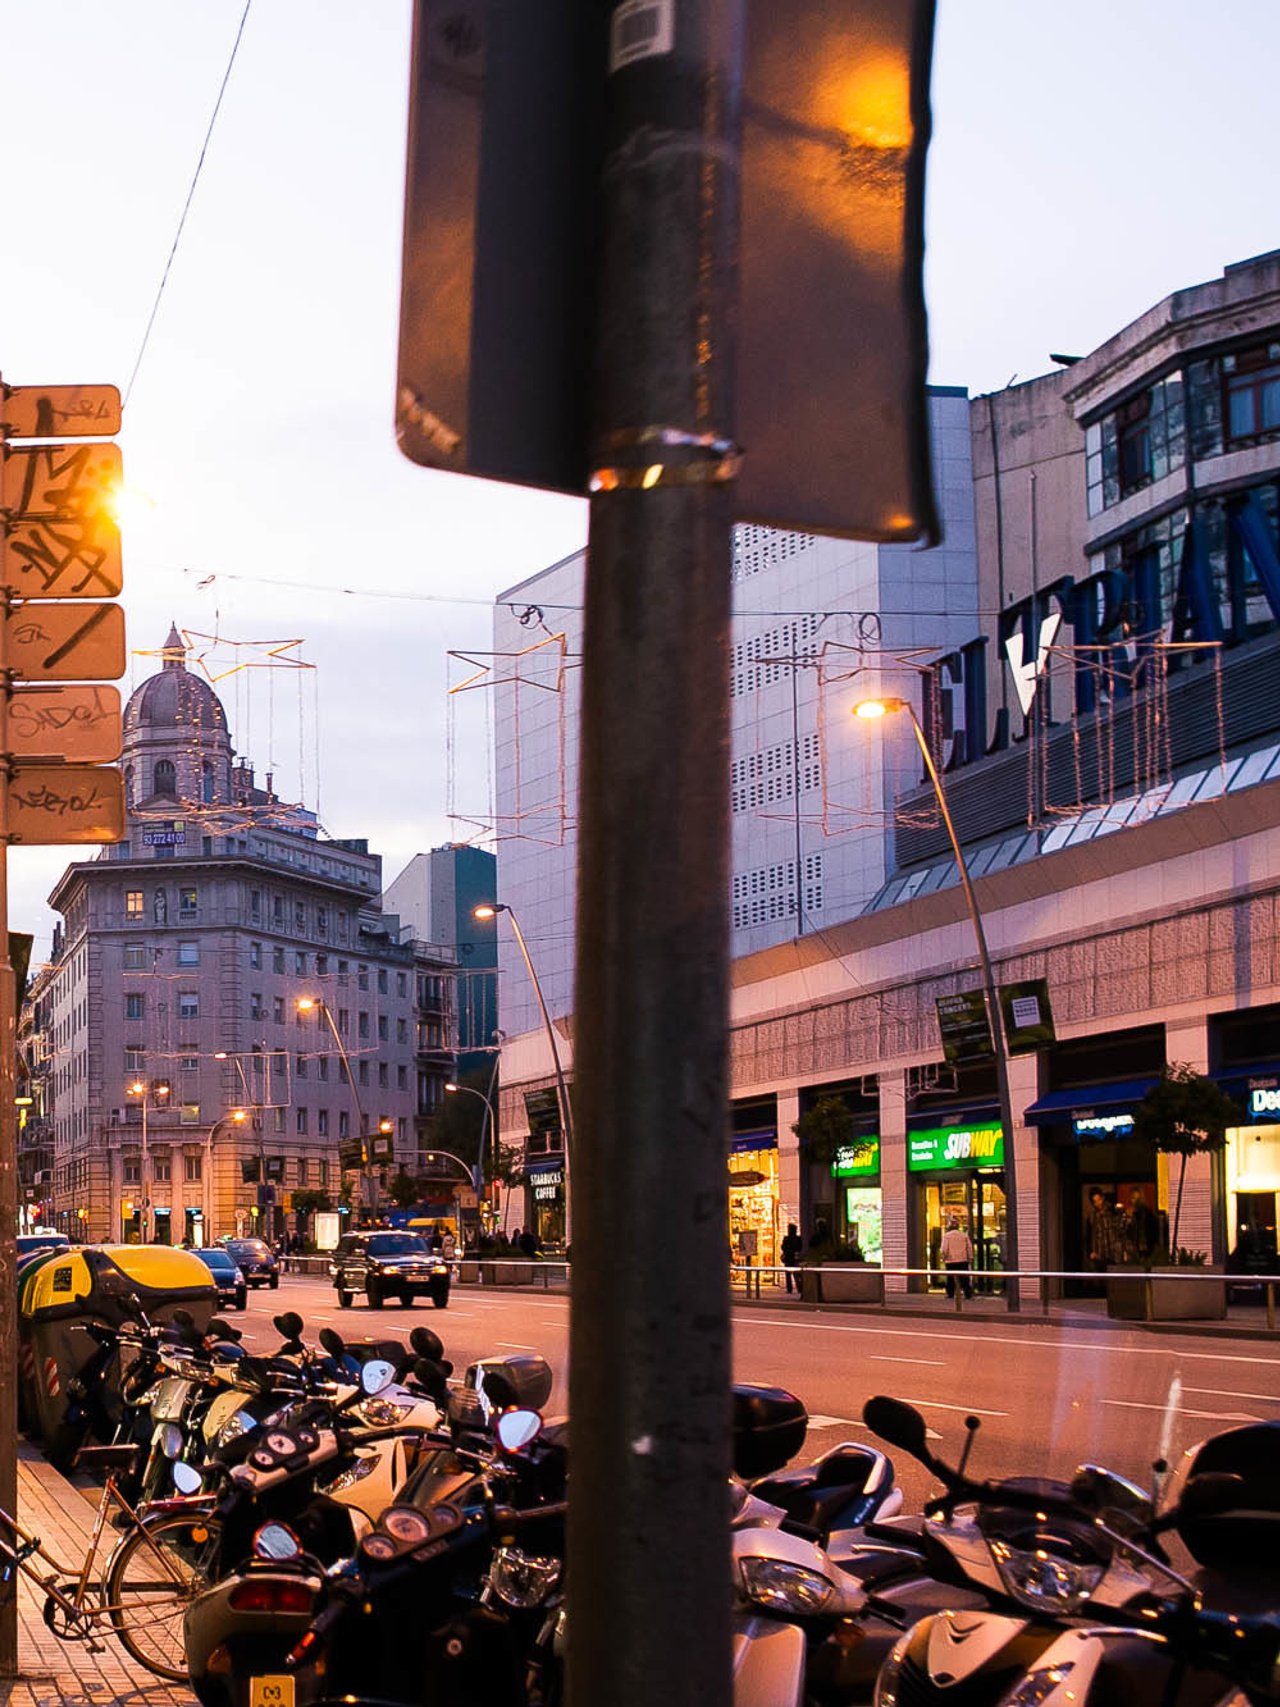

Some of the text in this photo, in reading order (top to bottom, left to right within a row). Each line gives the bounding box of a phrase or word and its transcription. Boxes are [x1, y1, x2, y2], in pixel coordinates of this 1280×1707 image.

[943, 1128, 1004, 1160] SUBWAY
[530, 1171, 562, 1186] STARBUCKS
[535, 1186, 556, 1200] COFFEE
